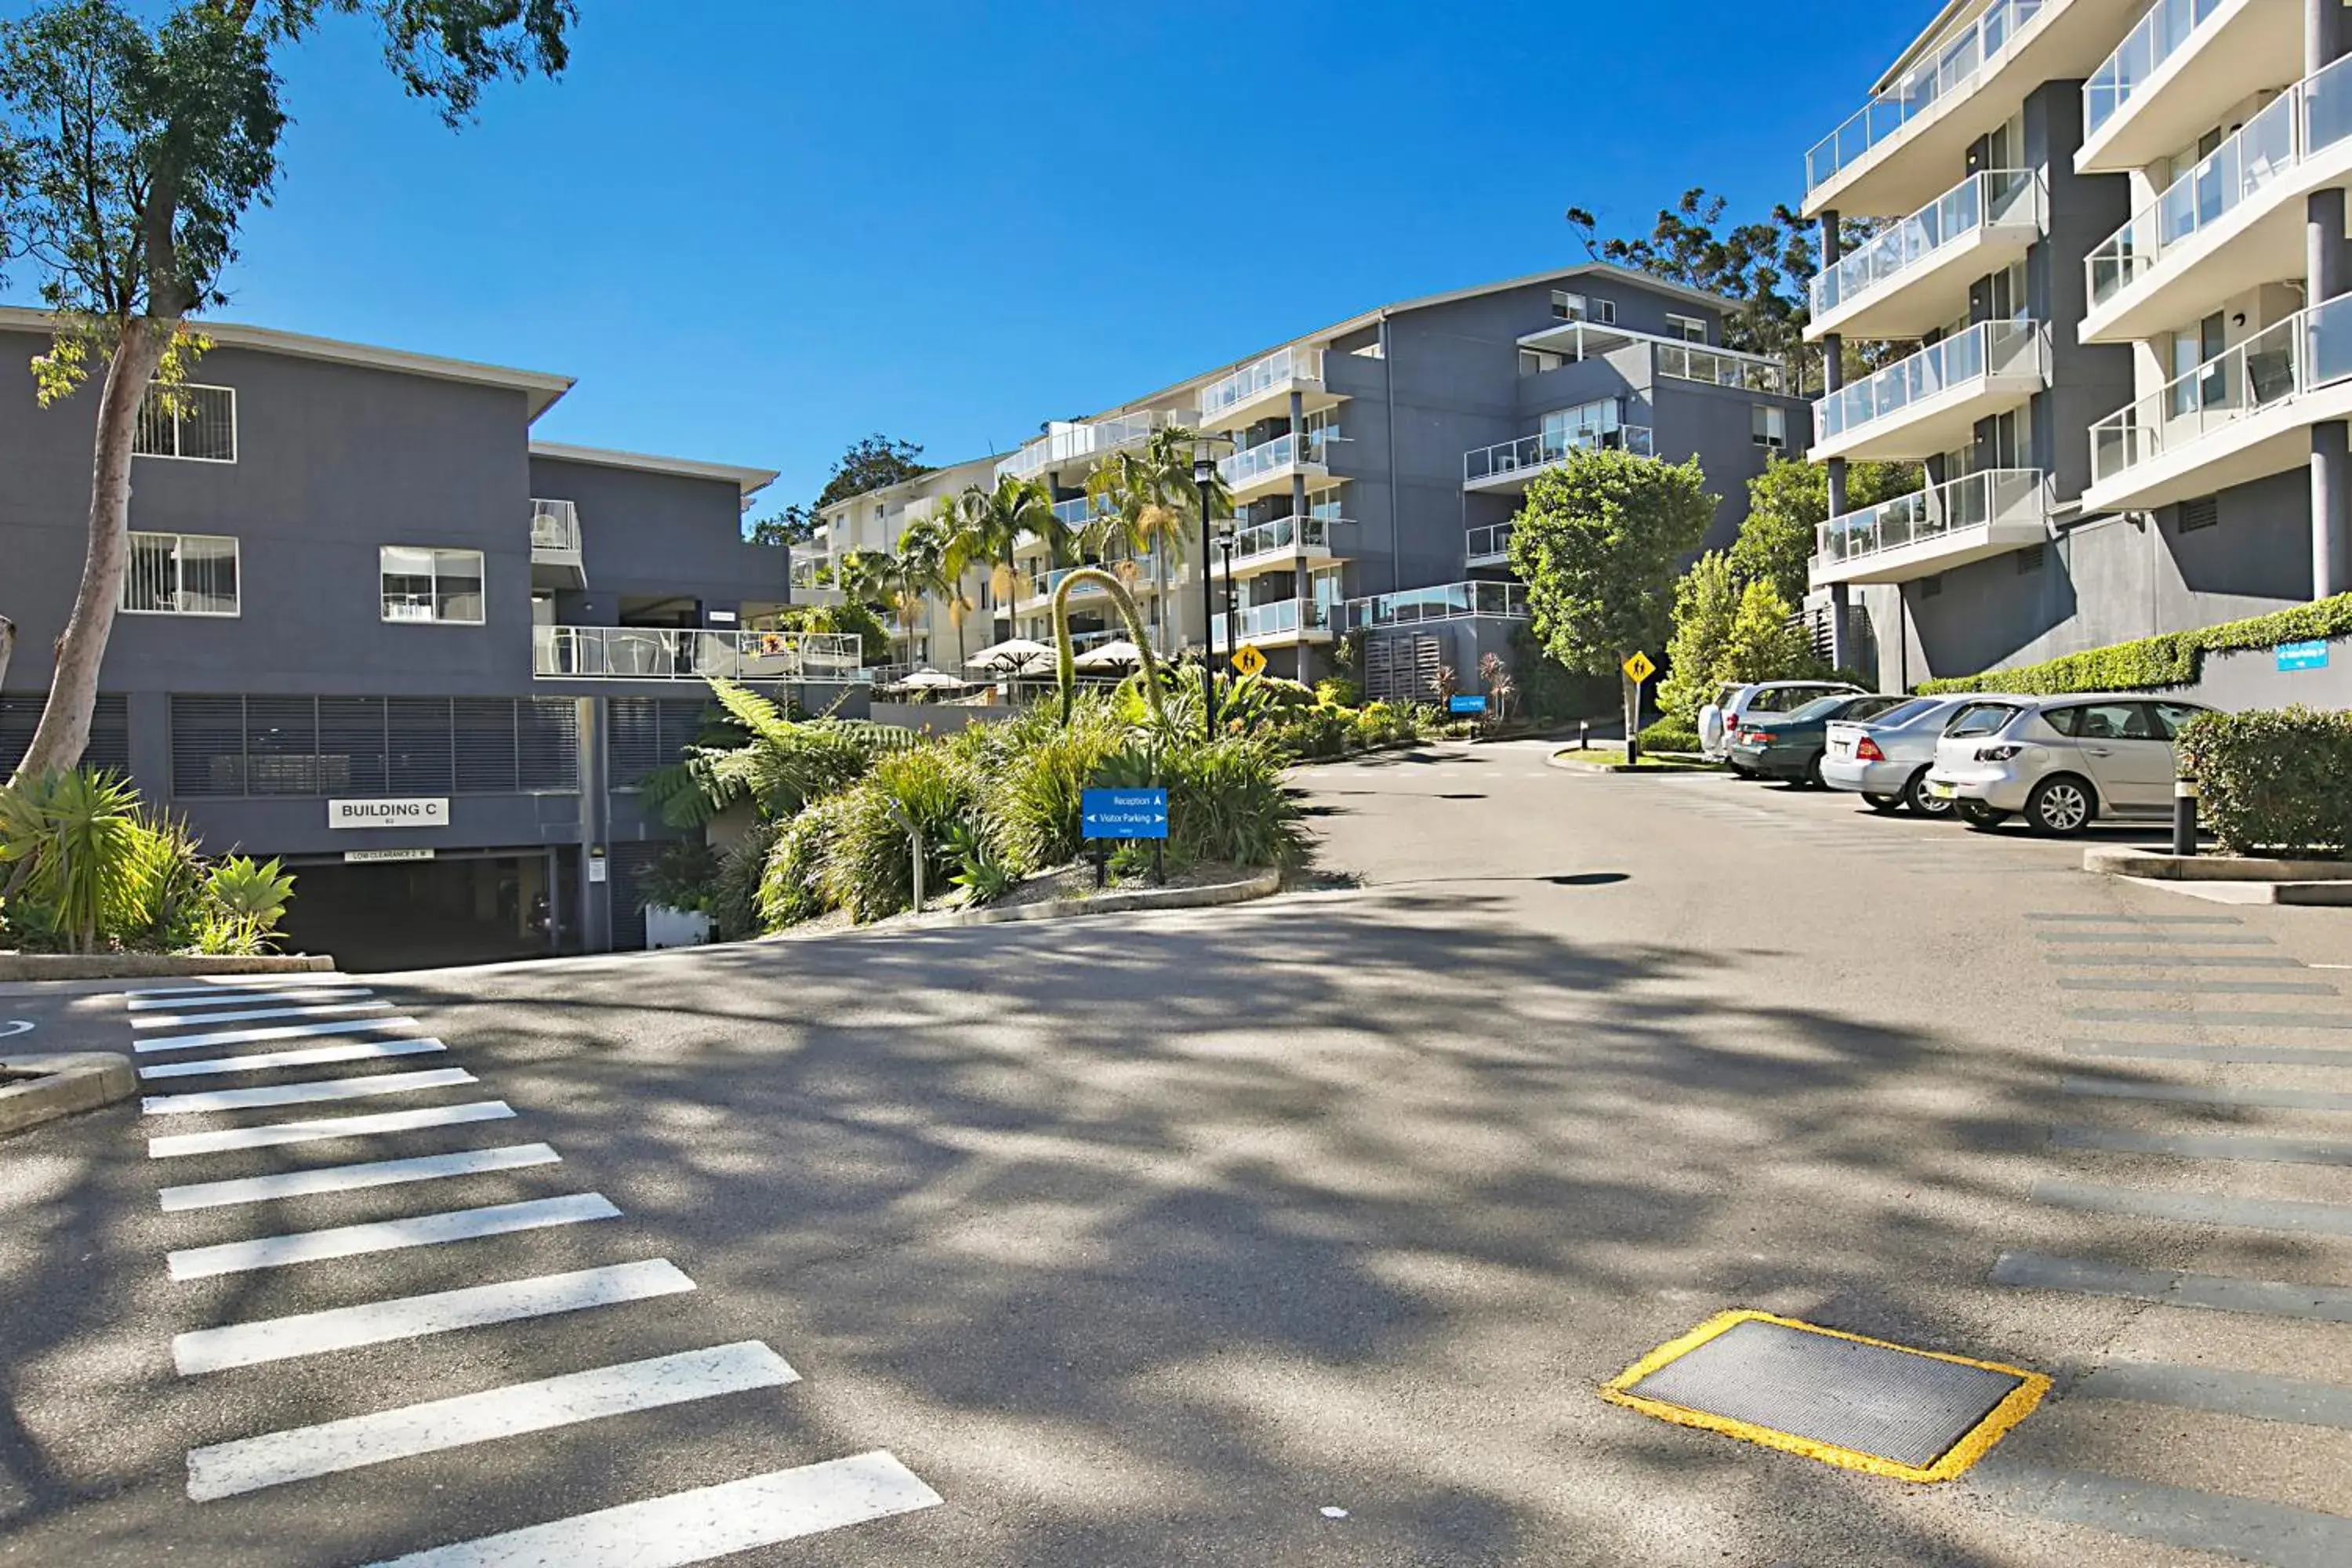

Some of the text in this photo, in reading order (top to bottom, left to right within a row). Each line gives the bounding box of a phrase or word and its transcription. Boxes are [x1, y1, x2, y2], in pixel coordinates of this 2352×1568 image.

[1114, 796, 1150, 806] Reception
[343, 803, 437, 816] BUILDING C
[1100, 813, 1151, 825] Visitor Parking
[353, 851, 369, 860] LOW
